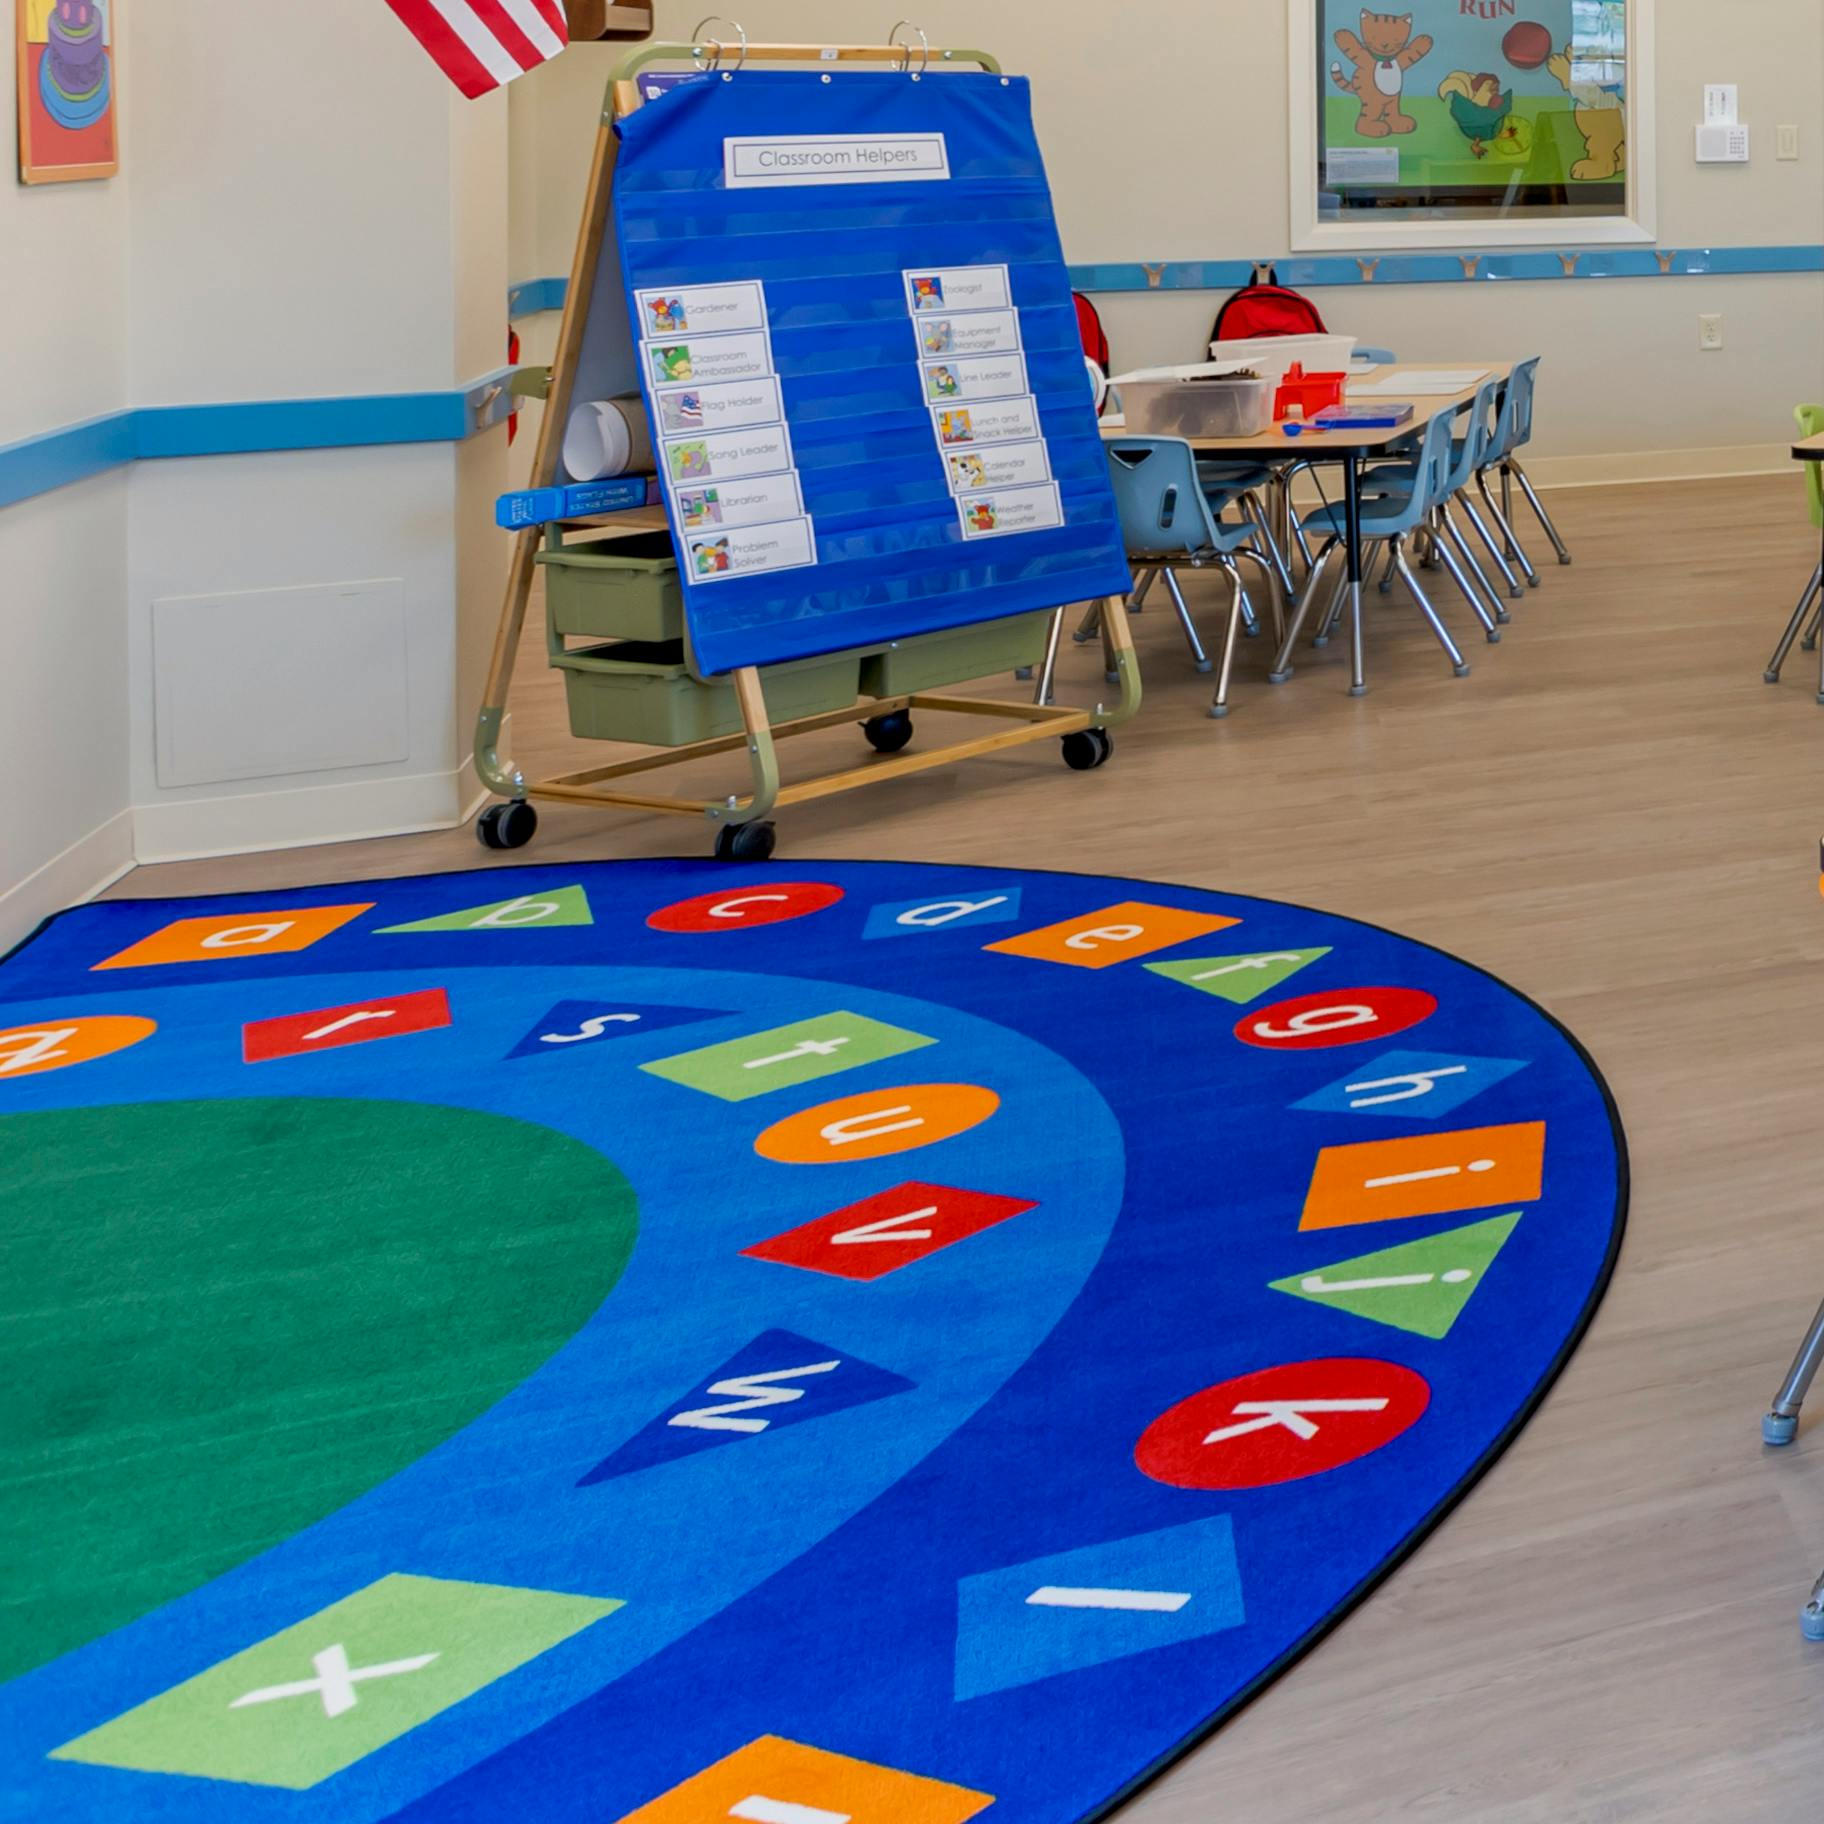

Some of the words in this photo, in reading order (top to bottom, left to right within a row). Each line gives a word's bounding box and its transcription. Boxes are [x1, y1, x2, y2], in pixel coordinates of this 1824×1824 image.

[758, 149, 850, 167] Classroom
[855, 146, 918, 165] Helpers
[685, 300, 739, 316] Gardener
[691, 349, 748, 365] Classroom
[693, 361, 762, 378] Ambassador
[980, 368, 1013, 382] Leader
[702, 398, 725, 413] Flag
[727, 394, 764, 409] Holder
[708, 448, 738, 463] Song
[739, 441, 778, 457] Leader
[720, 492, 768, 508] Librarian
[731, 538, 778, 555] Problem
[733, 553, 768, 569] Solver
[470, 896, 559, 928] b
[709, 894, 788, 918] c
[896, 895, 1008, 927] d
[200, 922, 294, 948] a
[1066, 924, 1143, 949] e
[1191, 954, 1300, 981] f
[302, 1010, 396, 1040] r
[540, 1013, 642, 1043] s
[1254, 1005, 1378, 1039] g
[742, 1036, 850, 1069] t
[1345, 1064, 1466, 1108] h
[820, 1105, 924, 1146] u
[1363, 1159, 1496, 1188] i
[831, 1206, 938, 1245] v
[1300, 1268, 1472, 1294] j
[667, 1359, 840, 1433] w
[1202, 1397, 1390, 1446] k
[228, 1642, 441, 1719] x
